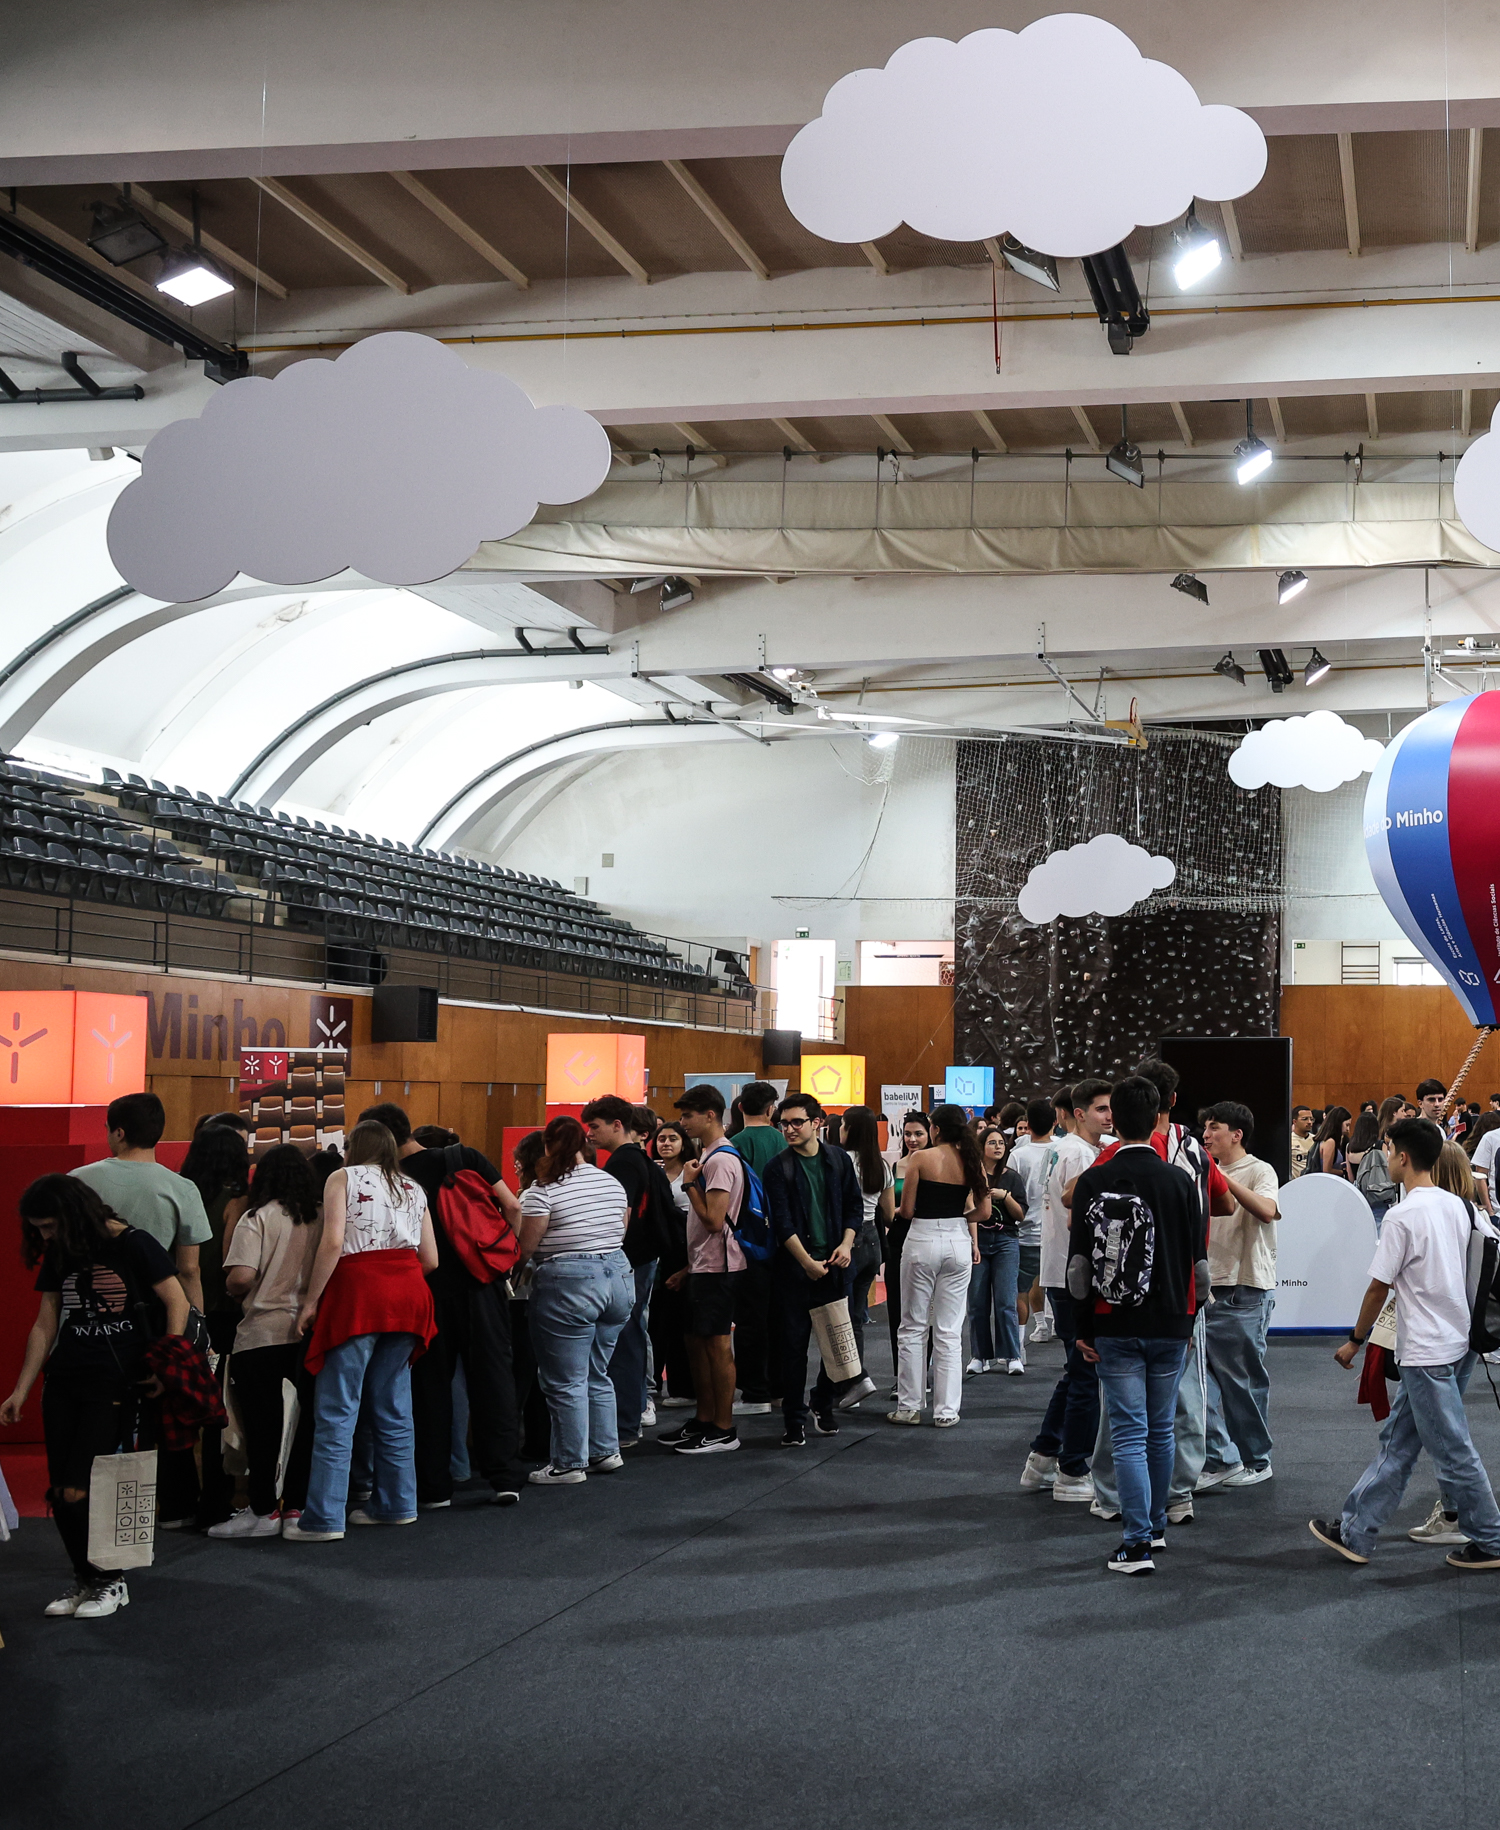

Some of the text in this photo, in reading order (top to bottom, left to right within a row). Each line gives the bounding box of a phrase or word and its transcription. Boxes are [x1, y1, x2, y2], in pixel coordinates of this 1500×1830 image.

[1396, 807, 1444, 829] Minho
[136, 990, 286, 1061] Minho
[1282, 1279, 1308, 1287] Minho
